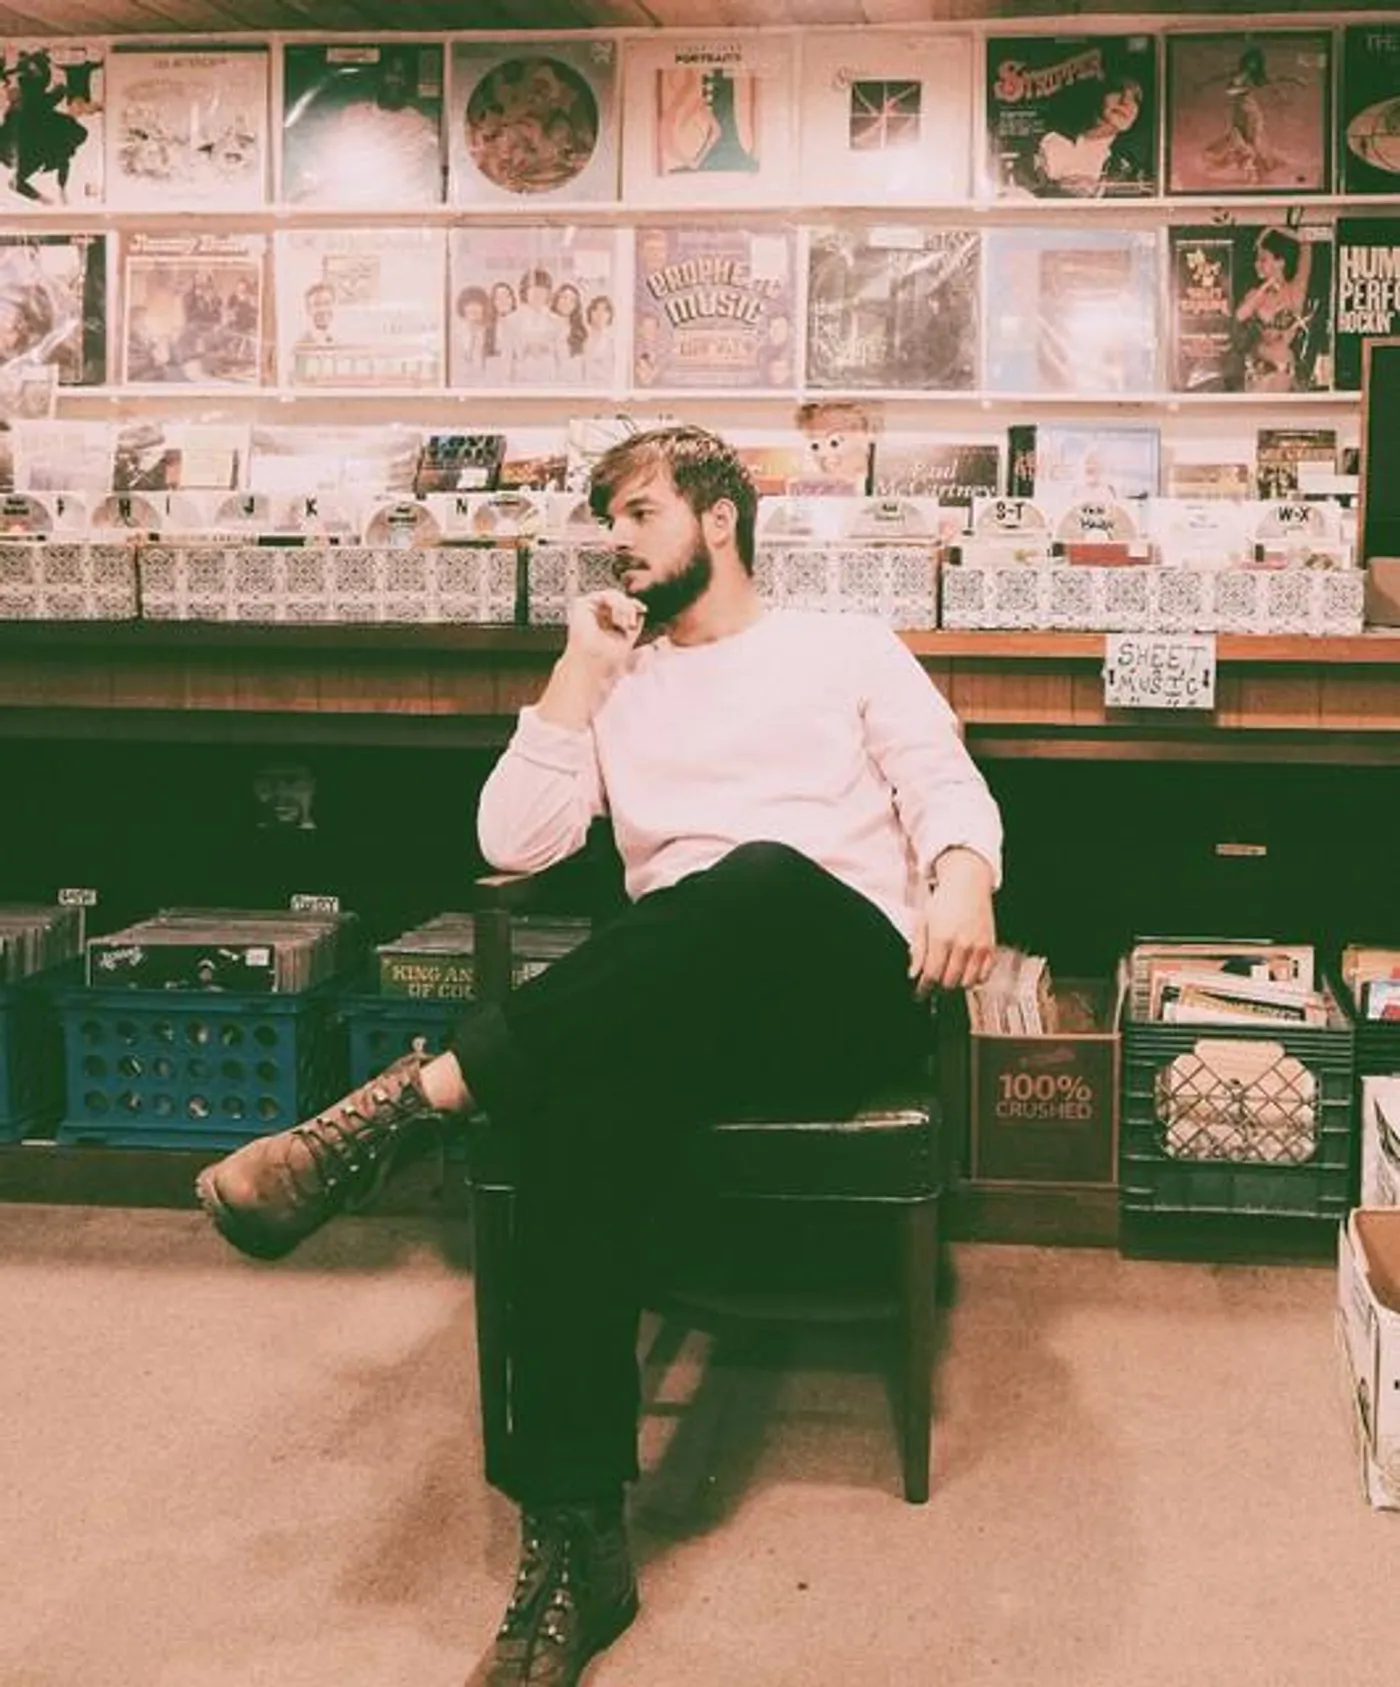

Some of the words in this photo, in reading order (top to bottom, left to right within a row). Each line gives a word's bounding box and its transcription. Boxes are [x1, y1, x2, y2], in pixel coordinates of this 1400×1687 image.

[664, 289, 766, 328] MUSIC
[243, 496, 255, 514] J
[305, 498, 318, 517] K
[455, 498, 468, 515] N
[996, 501, 1025, 521] S-T
[1278, 506, 1311, 522] W-X
[1118, 642, 1207, 668] SHEET
[1117, 671, 1199, 697] MUSIC
[392, 964, 441, 982] KING
[999, 1073, 1093, 1101] 100%
[996, 1101, 1093, 1119] CRUSHED
